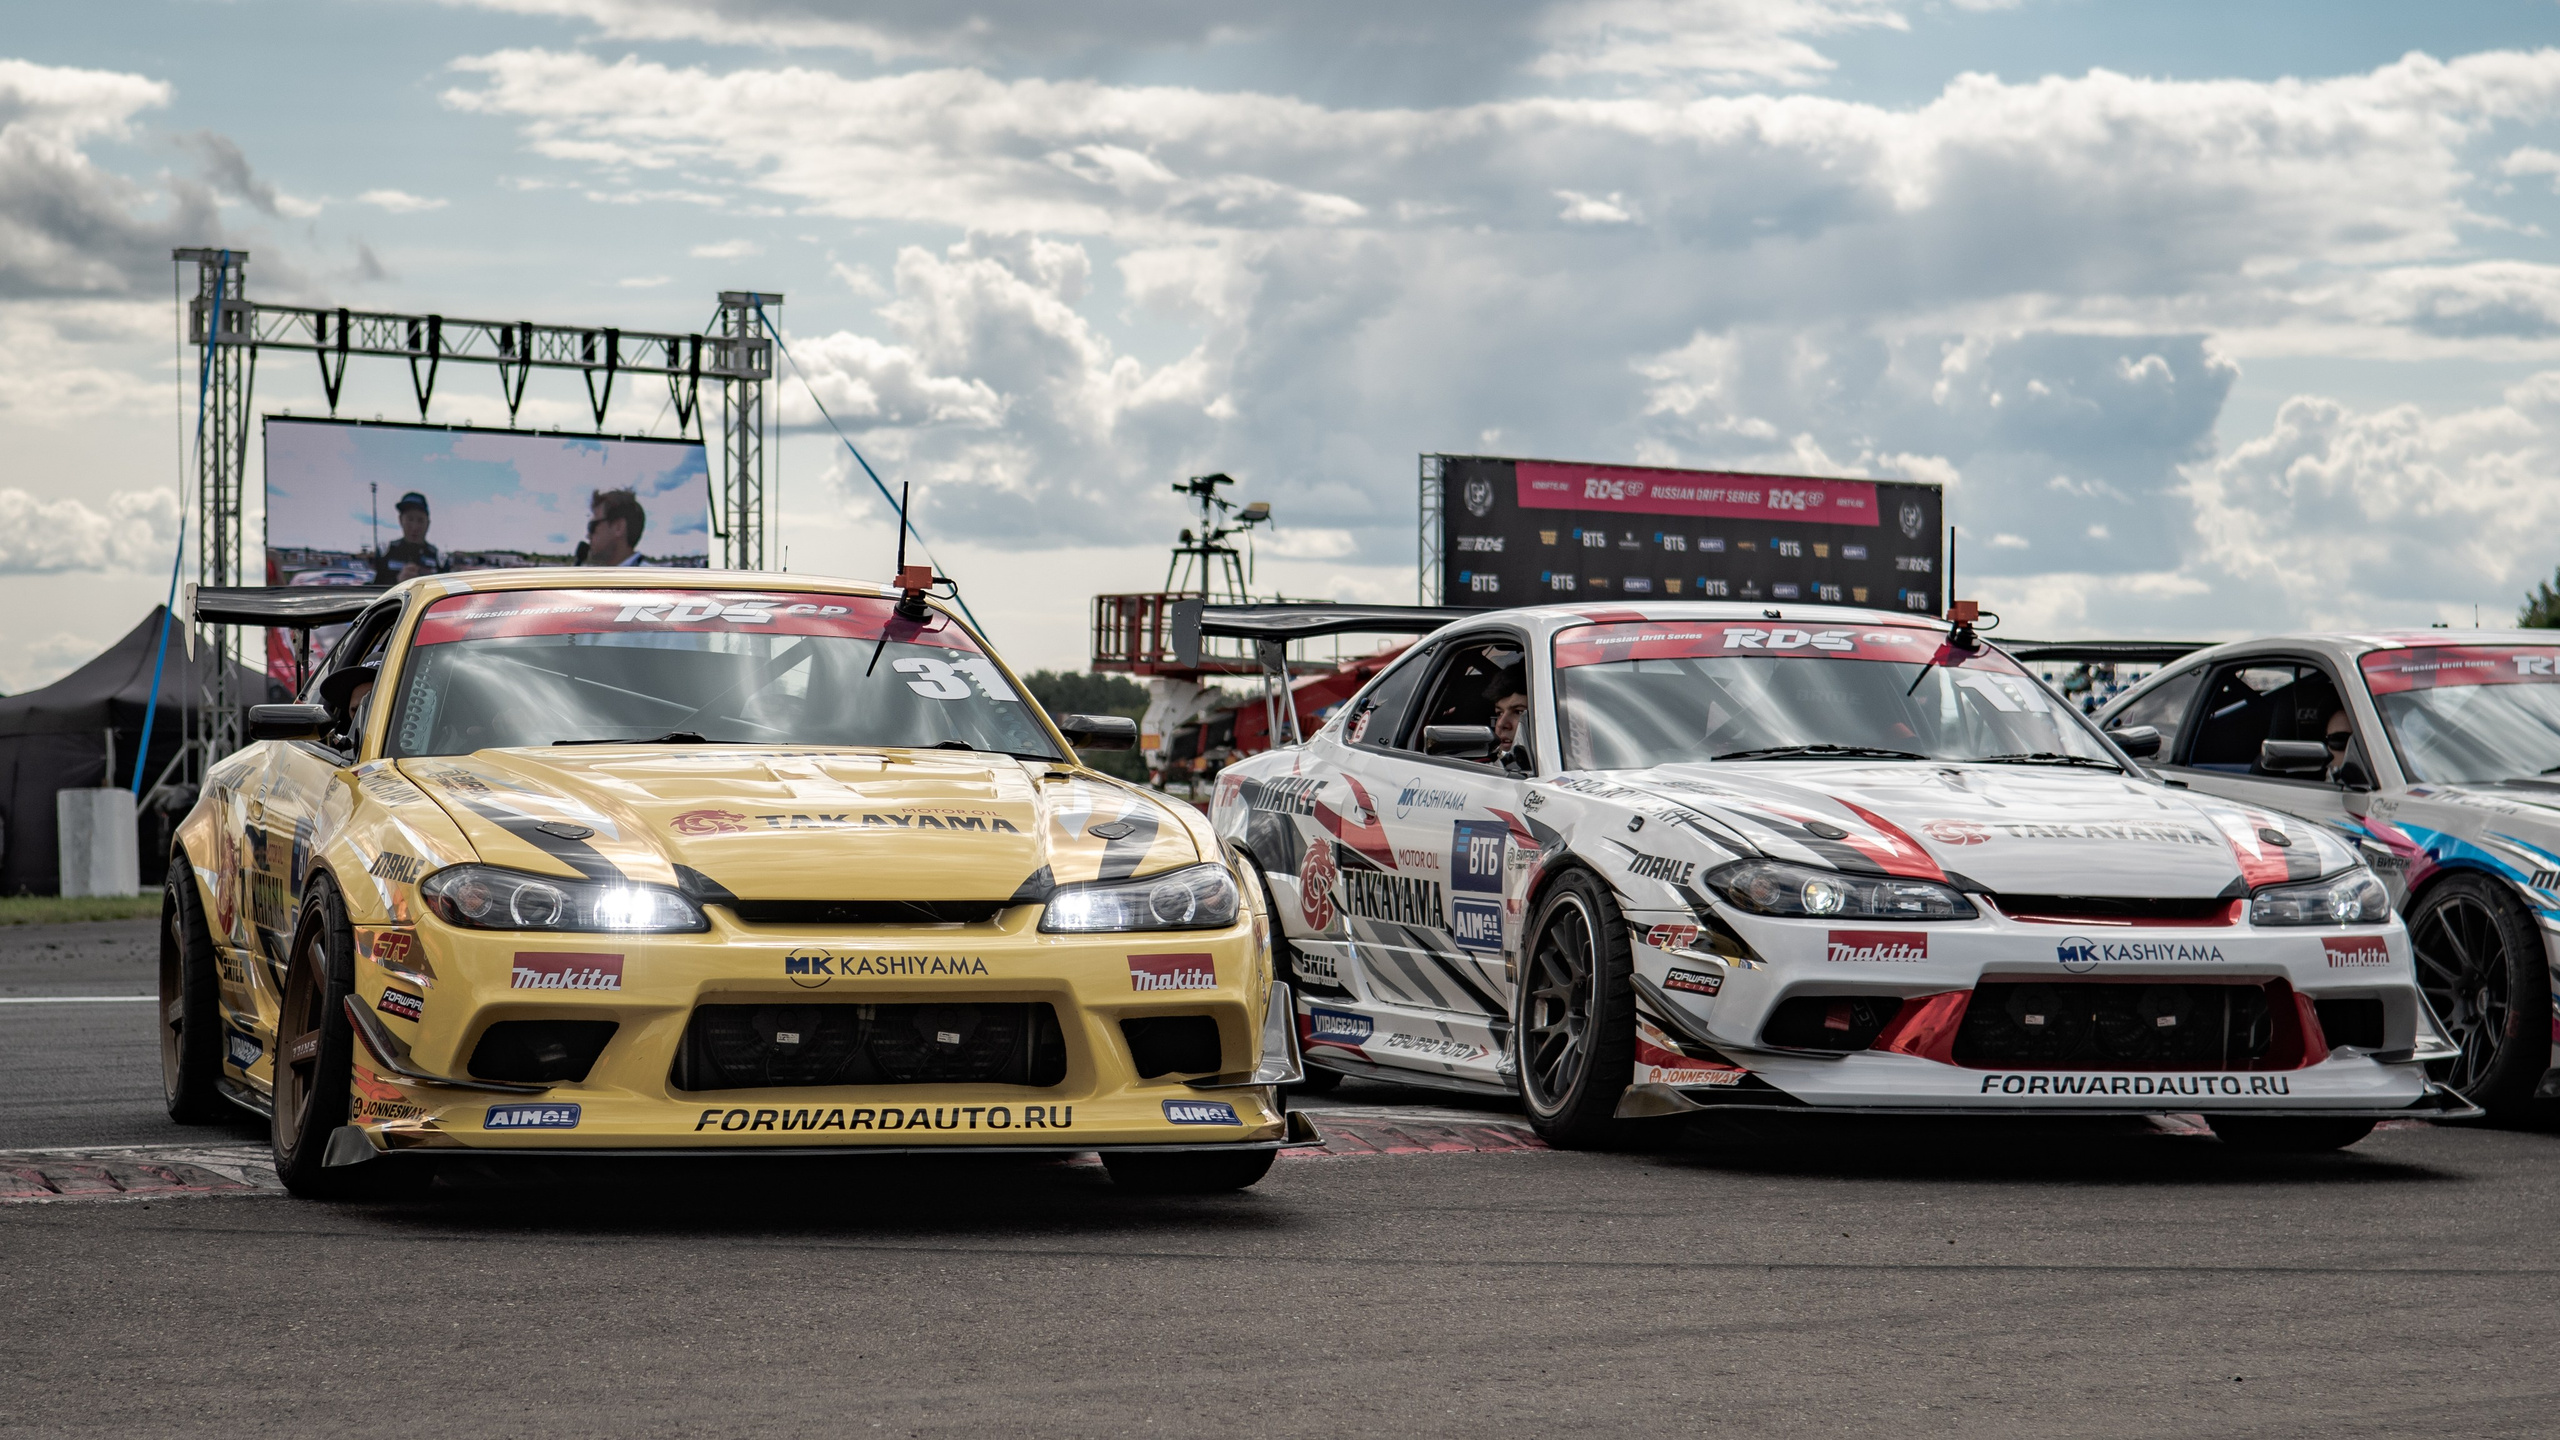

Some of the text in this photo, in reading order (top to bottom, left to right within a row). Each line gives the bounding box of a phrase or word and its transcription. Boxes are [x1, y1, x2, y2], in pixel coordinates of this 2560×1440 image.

[1584, 478, 1645, 500] RDS GP
[1651, 486, 1761, 505] RUSSIAN DRIFT SERIES
[1768, 489, 1806, 510] RDS
[1474, 538, 1505, 552] RDS
[1582, 531, 1606, 548] ВТБ
[1663, 535, 1687, 551] ВТБ
[1779, 541, 1801, 557] ВТБ
[1909, 557, 1932, 572] RDS
[1471, 574, 1500, 592] ВТБ
[1551, 574, 1575, 590] ВТБ
[1705, 580, 1728, 596] ВТБ
[1820, 585, 1842, 601] ВТБ
[1907, 593, 1928, 609] ВТБ
[466, 603, 593, 620] Russian Drift Series
[614, 601, 851, 624] RDS GP
[1595, 633, 1703, 645] Russian Drift Series
[1723, 628, 1913, 650] RDS GP
[2401, 660, 2496, 673] Russian Drift Series
[892, 657, 1020, 702] 31
[1955, 676, 2050, 713] 11
[1252, 776, 1329, 817] MAHLE
[1397, 788, 1468, 811] MK KASHIYAMA
[973, 809, 1003, 817] OIL
[755, 814, 1021, 834] TAKAYAMA
[1994, 823, 2220, 847] TAKAYAMA
[1398, 849, 1439, 870] MOTOR OIL
[1469, 837, 1500, 876] ВТБ
[369, 851, 425, 884] MAHLE
[1627, 853, 1695, 886] MAHLE
[1342, 867, 1447, 931] TAKAYAMA
[1456, 911, 1502, 942] AIMOL
[1646, 924, 1699, 948] CTR
[373, 932, 412, 962] CTR
[2056, 944, 2225, 963] MK KASHIYAMA
[223, 955, 245, 984] SKILL
[785, 956, 989, 975] MK KASHIYAMA
[1304, 953, 1337, 979] SKILL
[1667, 981, 1715, 993] RACING
[1669, 970, 1721, 987] FORWARD
[1384, 1033, 1473, 1060] FORWARD AUTO
[1663, 1070, 1740, 1086] JONNESWAY
[1981, 1075, 2290, 1096] FORWARDAUTO.RU
[363, 1102, 427, 1121] JONNESWAY
[488, 1109, 575, 1126] AIMOL
[694, 1106, 1073, 1132] FORWARDAUTO.RU
[1170, 1105, 1236, 1121] AIMOL
